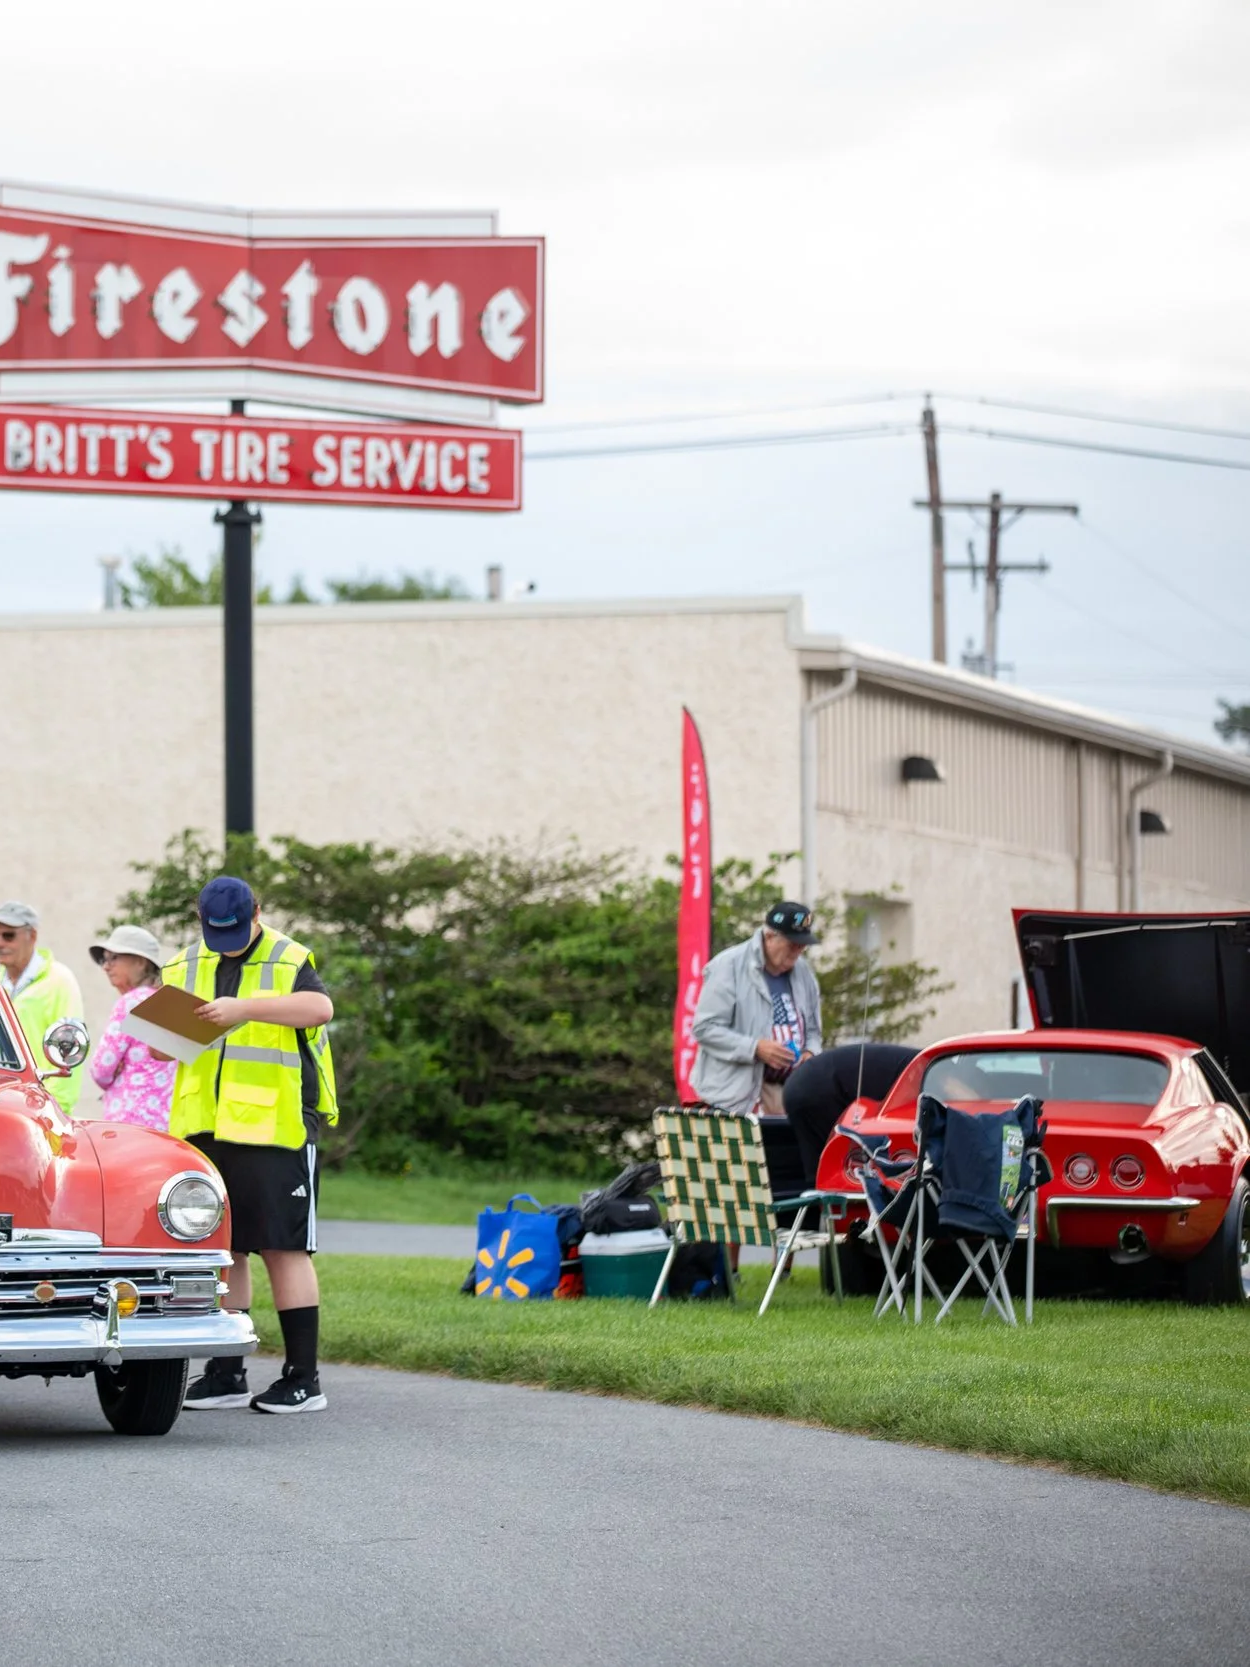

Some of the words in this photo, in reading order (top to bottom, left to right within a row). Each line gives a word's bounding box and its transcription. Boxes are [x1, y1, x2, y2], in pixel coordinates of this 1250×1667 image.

[4, 419, 173, 480] BRITT'S
[191, 428, 290, 484] TIRE
[311, 434, 490, 494] SERVICE
